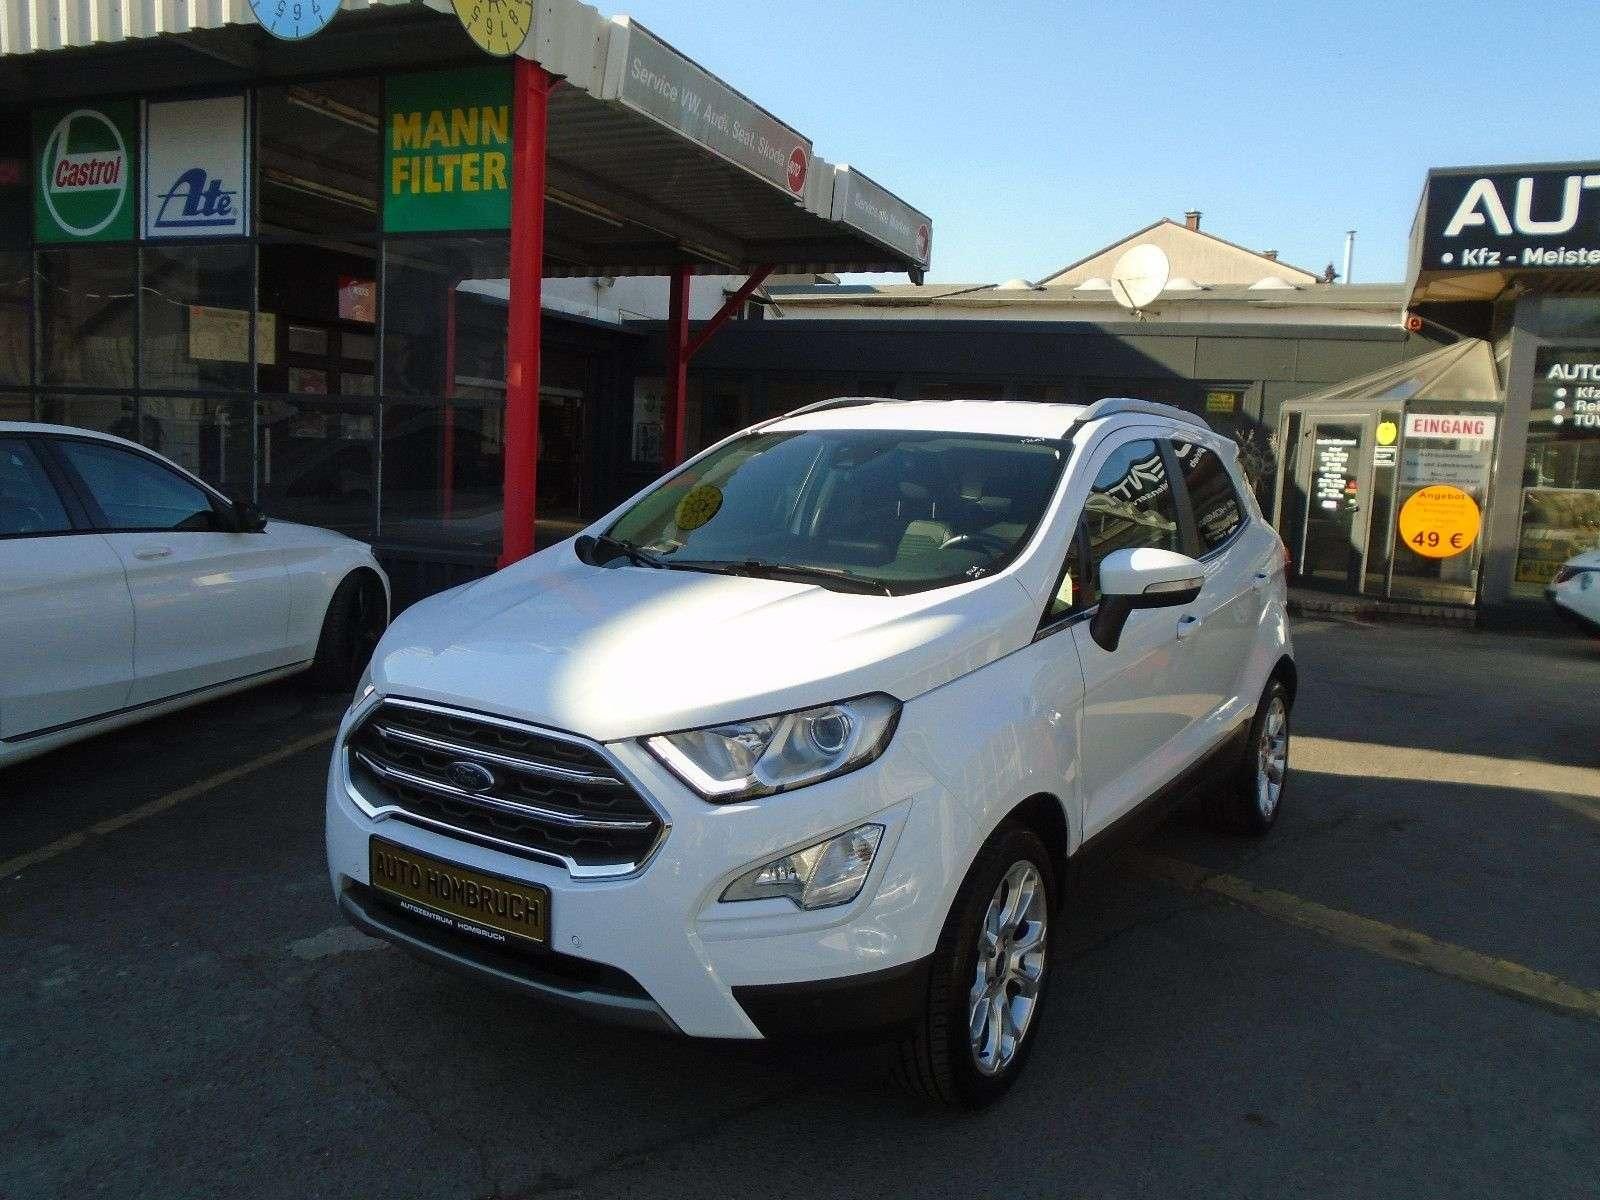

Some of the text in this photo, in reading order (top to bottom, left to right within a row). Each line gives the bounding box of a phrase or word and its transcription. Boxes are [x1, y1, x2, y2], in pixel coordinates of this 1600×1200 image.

[631, 57, 679, 98] Service
[392, 105, 509, 151] MANN
[55, 156, 122, 189] Castrol
[392, 152, 508, 195] FILTER
[155, 168, 237, 227] Ate
[1462, 247, 1501, 267] Kfz
[1413, 418, 1485, 436] EINGANG
[1419, 490, 1466, 501] Angebot
[1412, 531, 1464, 549] 49 €
[376, 851, 543, 928] AUTO HOMBRUCH
[400, 901, 506, 943] AUTOZENTRUM HOMBRUCH
